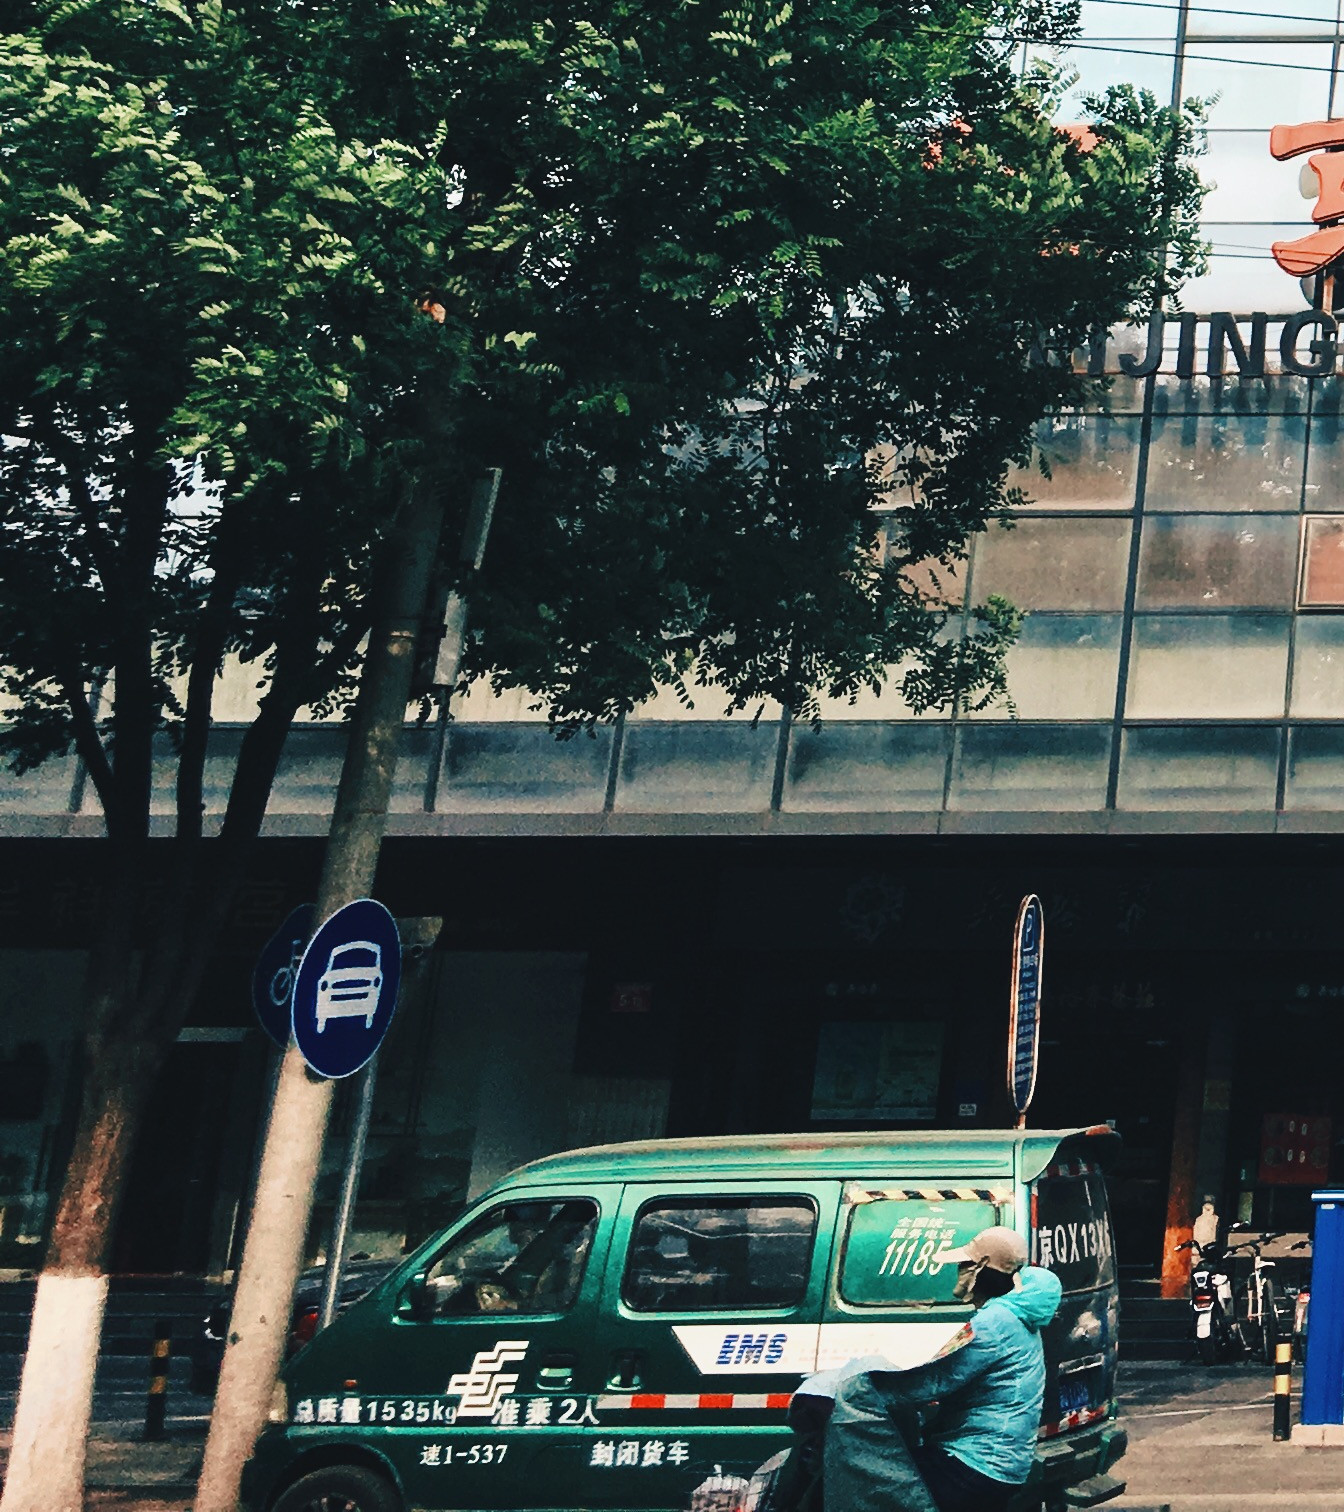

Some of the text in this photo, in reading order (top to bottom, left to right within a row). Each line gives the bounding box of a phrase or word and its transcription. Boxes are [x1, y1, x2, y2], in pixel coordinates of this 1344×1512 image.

[1028, 310, 1338, 379] IJING
[889, 1228, 957, 1240] 服务电话
[896, 1216, 960, 1229] 全国统一
[878, 1240, 954, 1276] 11185
[715, 1333, 788, 1365] EMS
[492, 1397, 600, 1426] 准乘2人
[419, 1444, 508, 1466] 速1-537
[589, 1440, 690, 1467] 封闭货车
